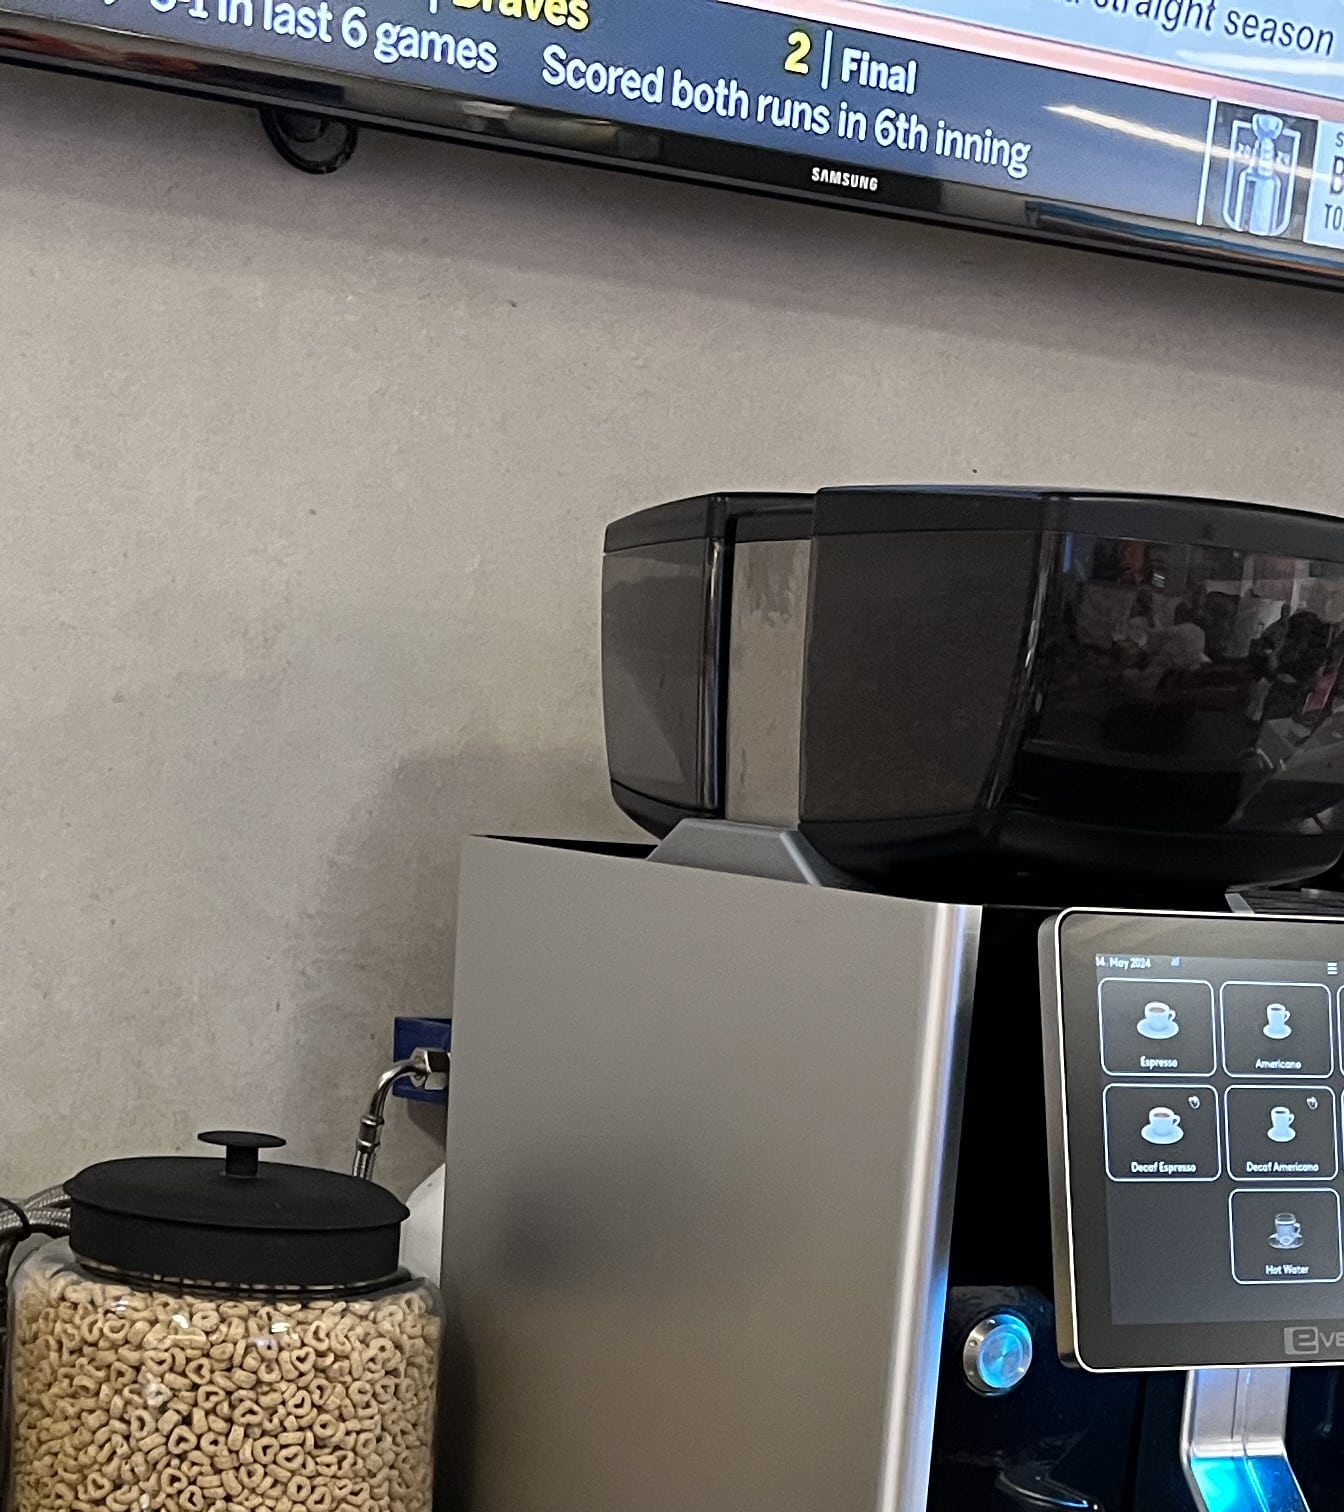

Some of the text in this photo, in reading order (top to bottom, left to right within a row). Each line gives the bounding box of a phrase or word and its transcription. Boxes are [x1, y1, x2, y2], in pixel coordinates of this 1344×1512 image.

[452, 0, 589, 30] aves
[263, 0, 332, 43] last
[341, 6, 369, 49] 6
[372, 20, 499, 75] games
[1223, 9, 1335, 56] season
[783, 30, 918, 96] 2 Final
[541, 43, 1033, 180] Scored both runs in 6th inning
[810, 167, 879, 192] SAMSUNG
[1109, 956, 1129, 970] May
[1130, 956, 1152, 969] 2024
[1140, 1055, 1179, 1070] Espresso
[1255, 1058, 1302, 1070] Americano
[1130, 1161, 1197, 1175] Decaf Espresso
[1246, 1161, 1320, 1173] Decaf Americano
[1265, 1264, 1310, 1275] Hot Water
